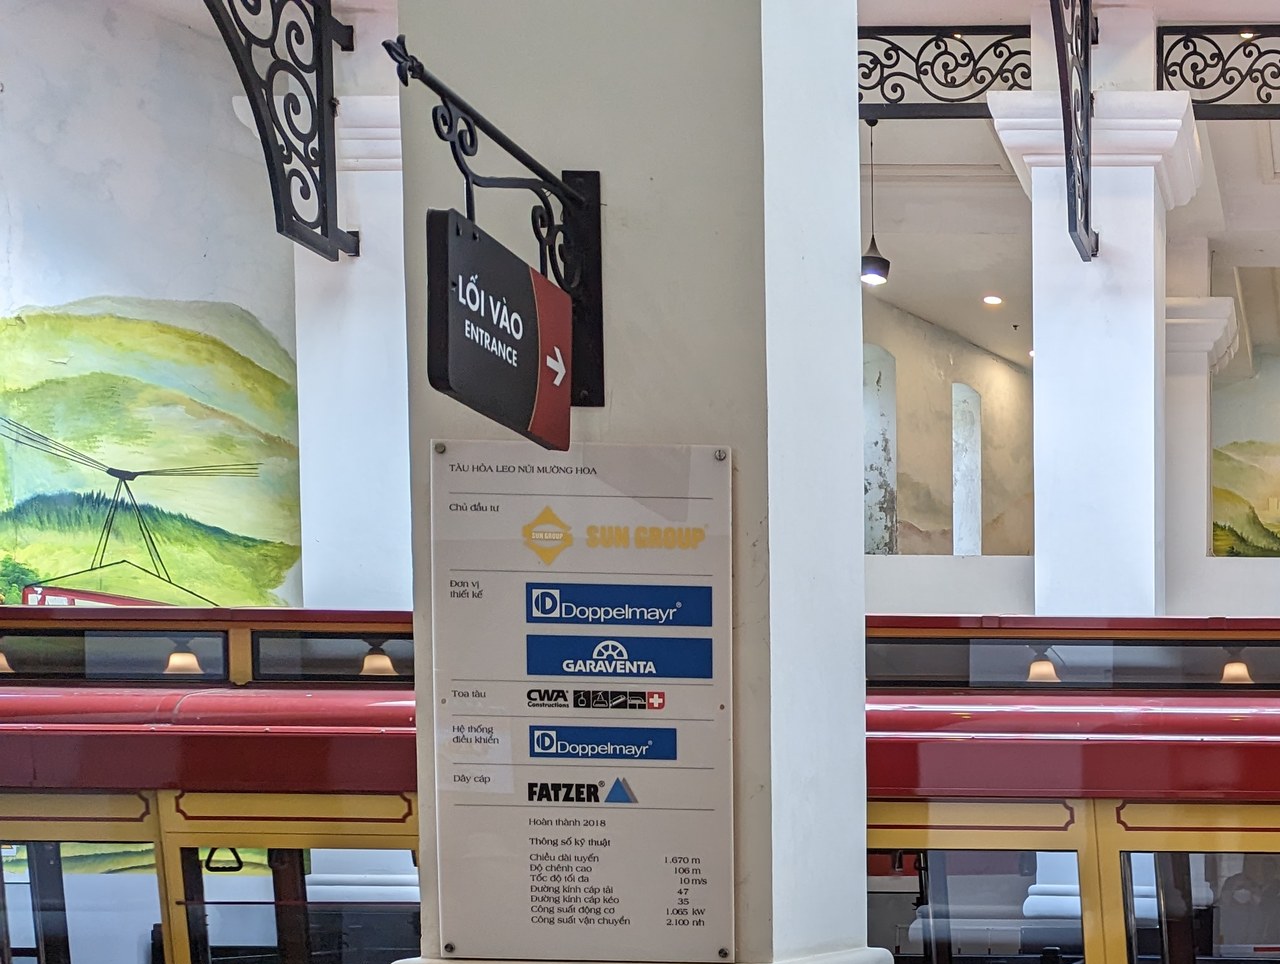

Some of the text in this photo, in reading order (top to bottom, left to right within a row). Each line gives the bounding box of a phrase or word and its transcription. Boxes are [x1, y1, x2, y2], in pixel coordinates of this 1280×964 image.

[458, 274, 523, 340] LỐI VÀO
[465, 319, 518, 367] ENTRANCE
[449, 462, 470, 473] TÀU
[495, 464, 516, 473] LEO
[575, 466, 598, 475] HOA
[531, 531, 564, 540] SUN GROUP
[586, 524, 706, 550] SUN GROUP
[561, 602, 678, 624] Doppelmayr
[562, 659, 657, 674] GARAVENTA
[451, 689, 487, 698] Toa tàu
[526, 689, 569, 702] CWA
[527, 700, 570, 708] Constructions
[557, 741, 650, 758] Doppelmayr
[453, 774, 491, 785] Dây cáp
[527, 782, 600, 803] FATZER
[583, 819, 607, 827] 2018
[528, 837, 559, 847] Thông
[664, 856, 690, 864] 1.670
[575, 865, 593, 873] cao
[674, 867, 702, 875] 106 m
[680, 877, 708, 885] 10 m/s
[583, 885, 601, 895] cáp
[583, 896, 601, 905] cáp
[602, 896, 620, 904] kéo
[677, 898, 690, 906] 35
[530, 904, 555, 915] Công
[666, 907, 706, 916] 1.065 kW
[530, 915, 556, 926] Công
[666, 918, 690, 927] 2.100
